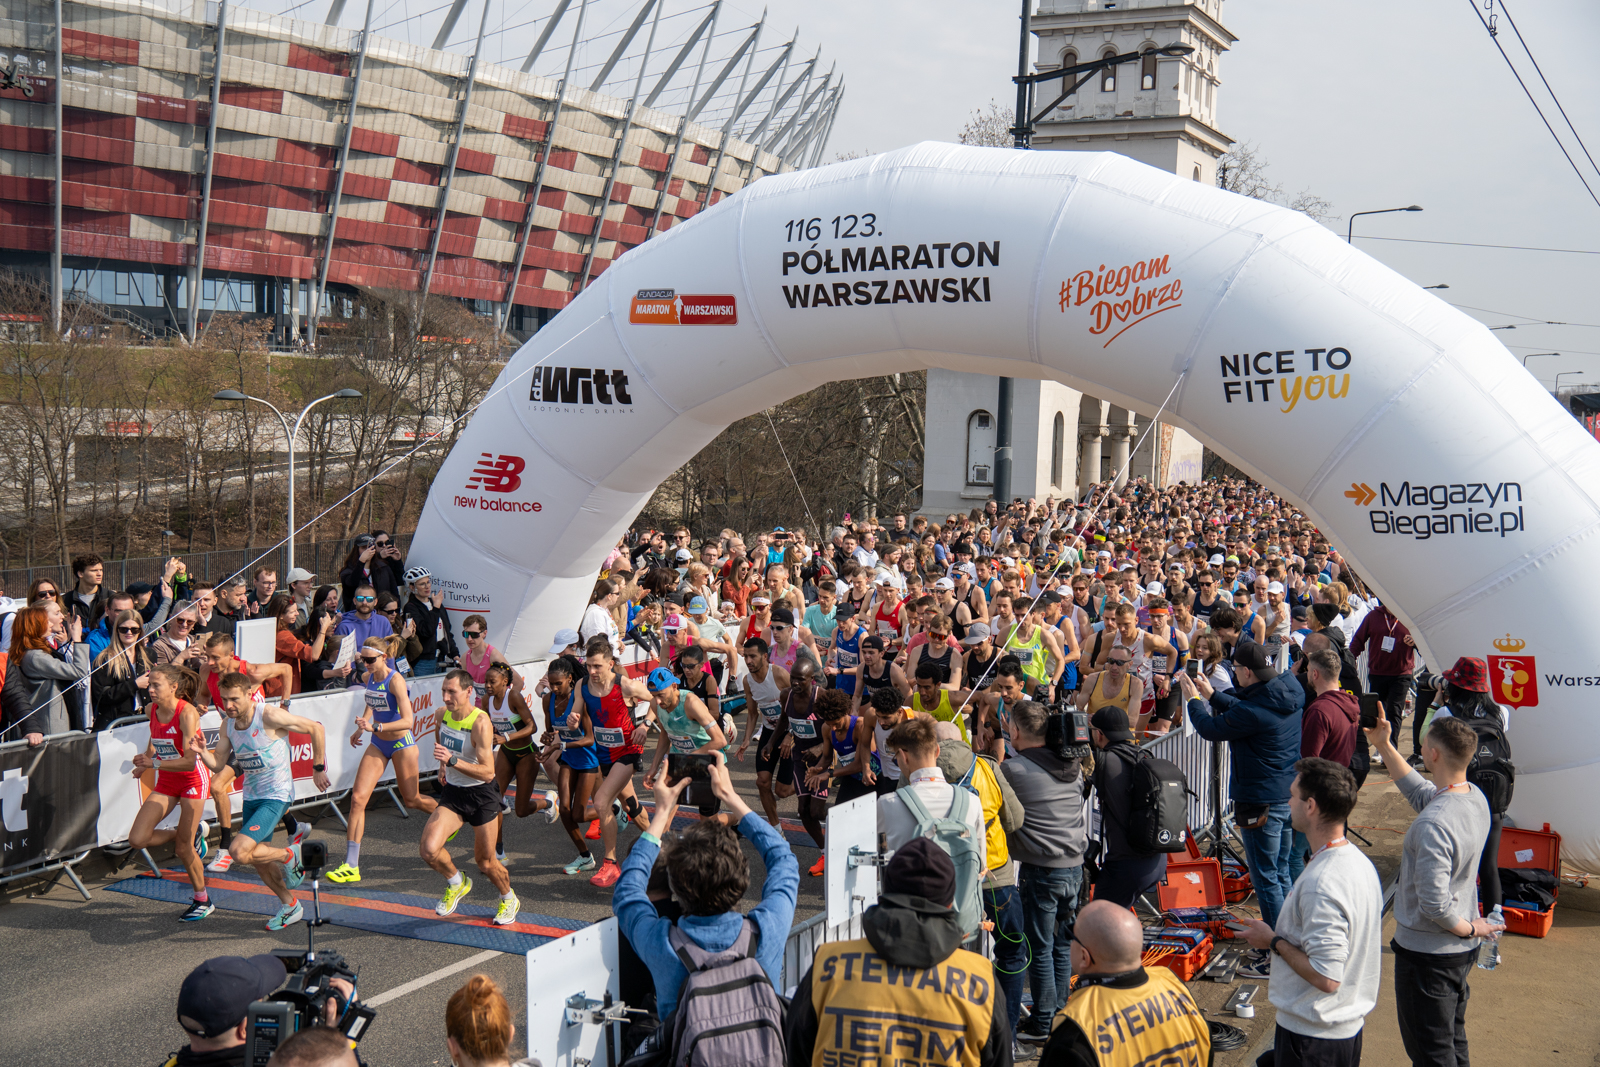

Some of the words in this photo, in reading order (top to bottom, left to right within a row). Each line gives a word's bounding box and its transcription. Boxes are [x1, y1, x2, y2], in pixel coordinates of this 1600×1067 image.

[784, 218, 821, 242] 116
[830, 213, 883, 239] 123.
[782, 241, 1000, 276] PÓŁMARATON
[782, 276, 991, 309] WARSZAWSKI
[1059, 254, 1171, 313] #Biegam
[635, 304, 670, 314] MARATON
[683, 305, 734, 315] WARSZAWSKI
[1220, 350, 1296, 378] NICE
[1304, 347, 1352, 372] TO
[542, 366, 632, 405] Witt
[1223, 379, 1275, 403] FIT
[1280, 373, 1351, 414] you
[528, 405, 585, 414] ISOTONIC
[453, 495, 477, 508] new
[480, 495, 542, 513] balance
[1380, 481, 1522, 511] Magazyn
[1369, 506, 1525, 539] Bieganie.pl
[448, 591, 490, 604] Turystyki
[443, 736, 455, 748] M11
[602, 734, 615, 742] M23
[820, 952, 989, 1006] STEWARD
[824, 1006, 968, 1062] TEAM
